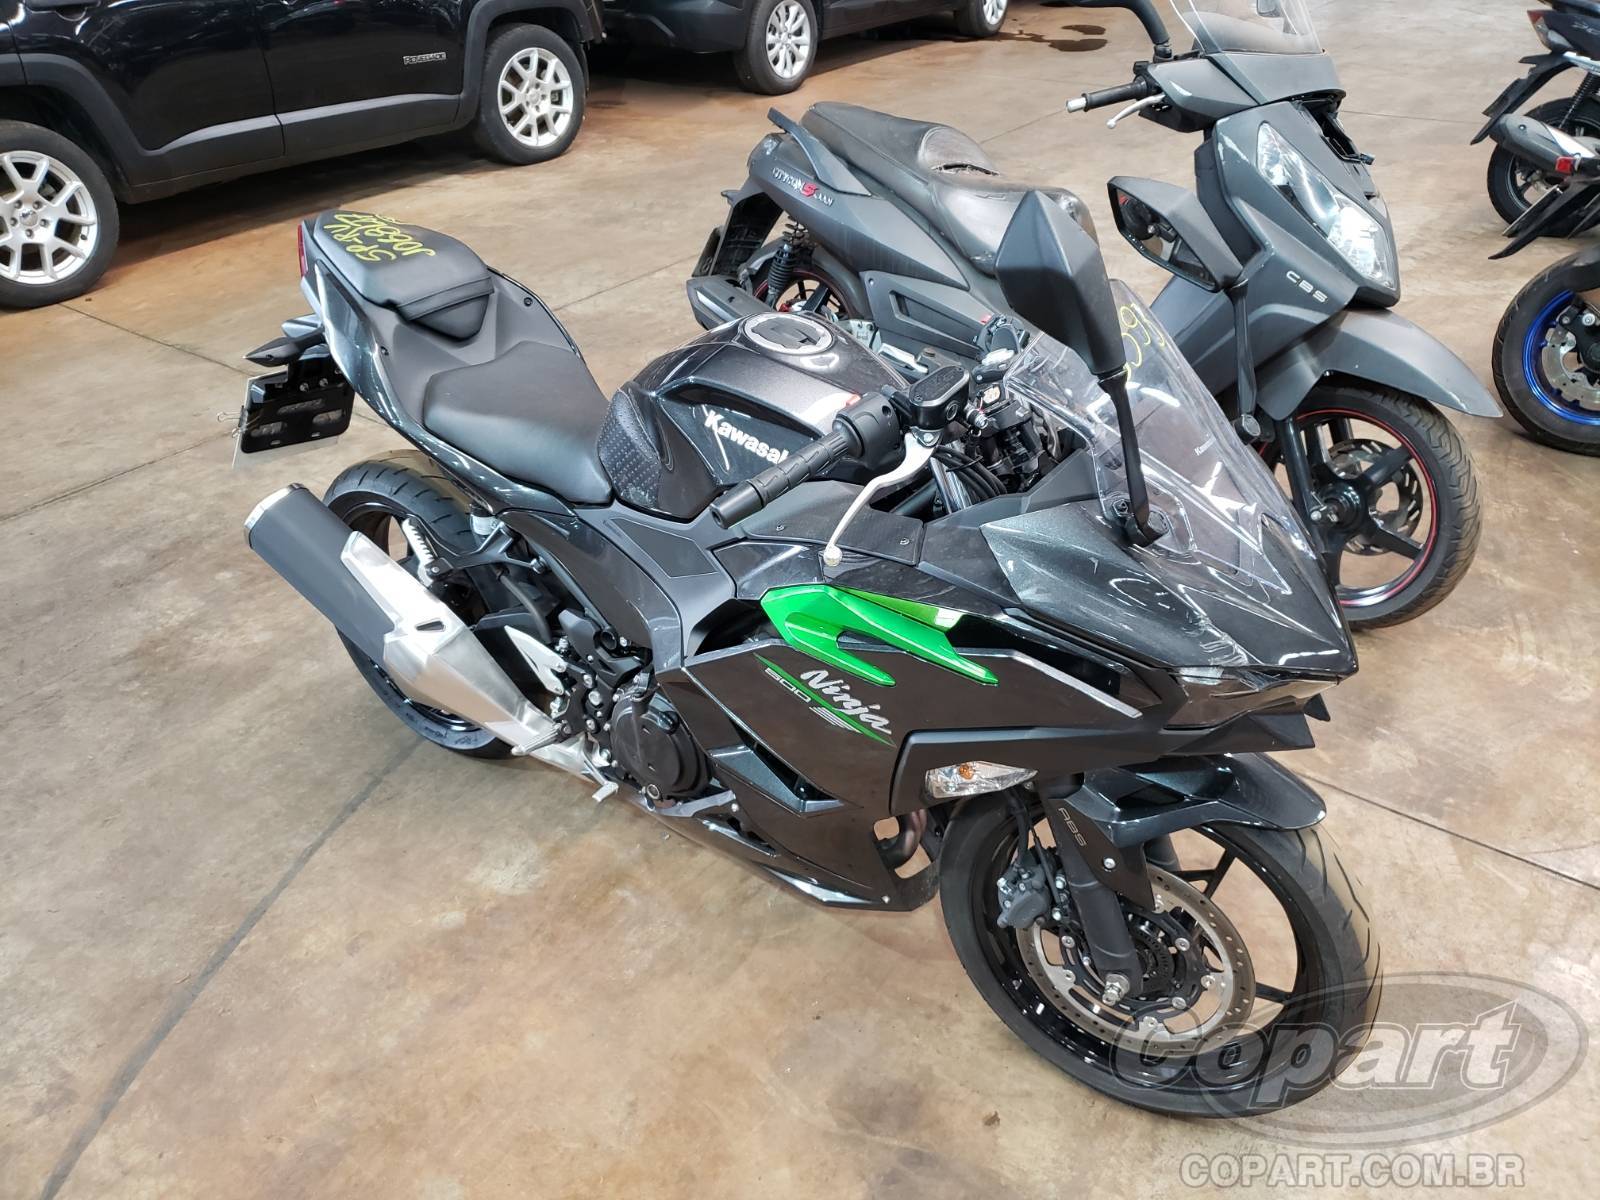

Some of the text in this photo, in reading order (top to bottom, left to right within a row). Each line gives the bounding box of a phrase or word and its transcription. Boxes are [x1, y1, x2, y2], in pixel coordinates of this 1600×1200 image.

[1286, 270, 1328, 303] CBS
[800, 669, 892, 735] Ninja
[1058, 807, 1087, 847] ABS
